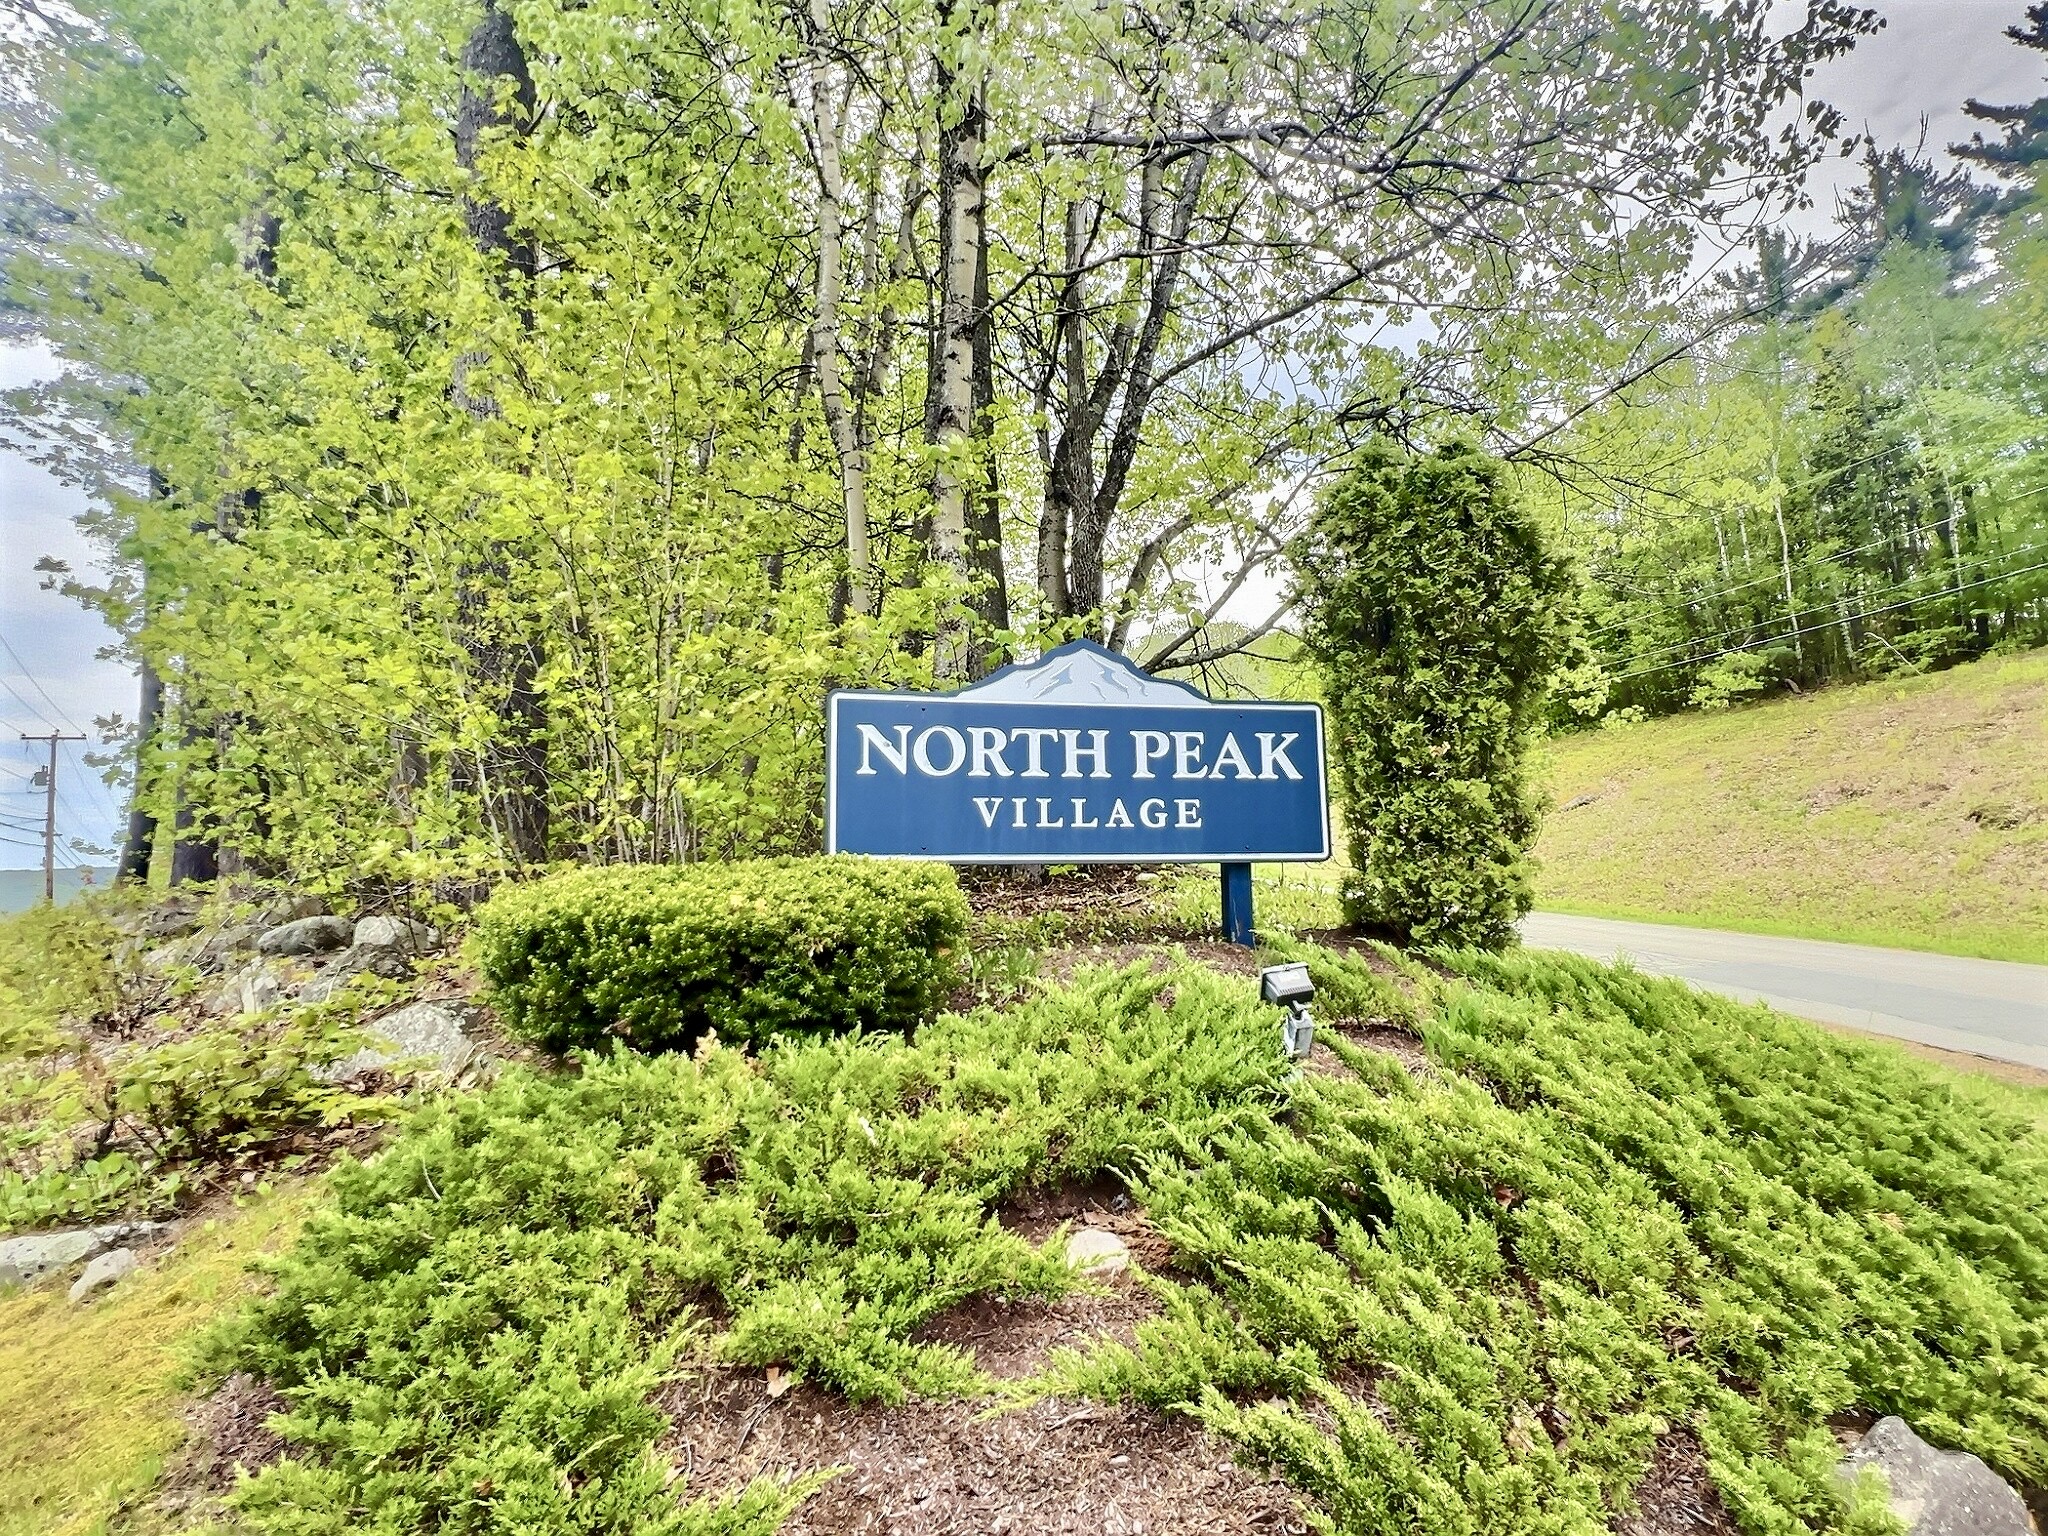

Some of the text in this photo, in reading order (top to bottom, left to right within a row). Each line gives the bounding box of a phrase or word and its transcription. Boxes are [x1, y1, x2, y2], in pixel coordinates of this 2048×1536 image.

[856, 724, 1304, 780] NORTH PEAK
[972, 797, 1203, 829] VILLAGE
